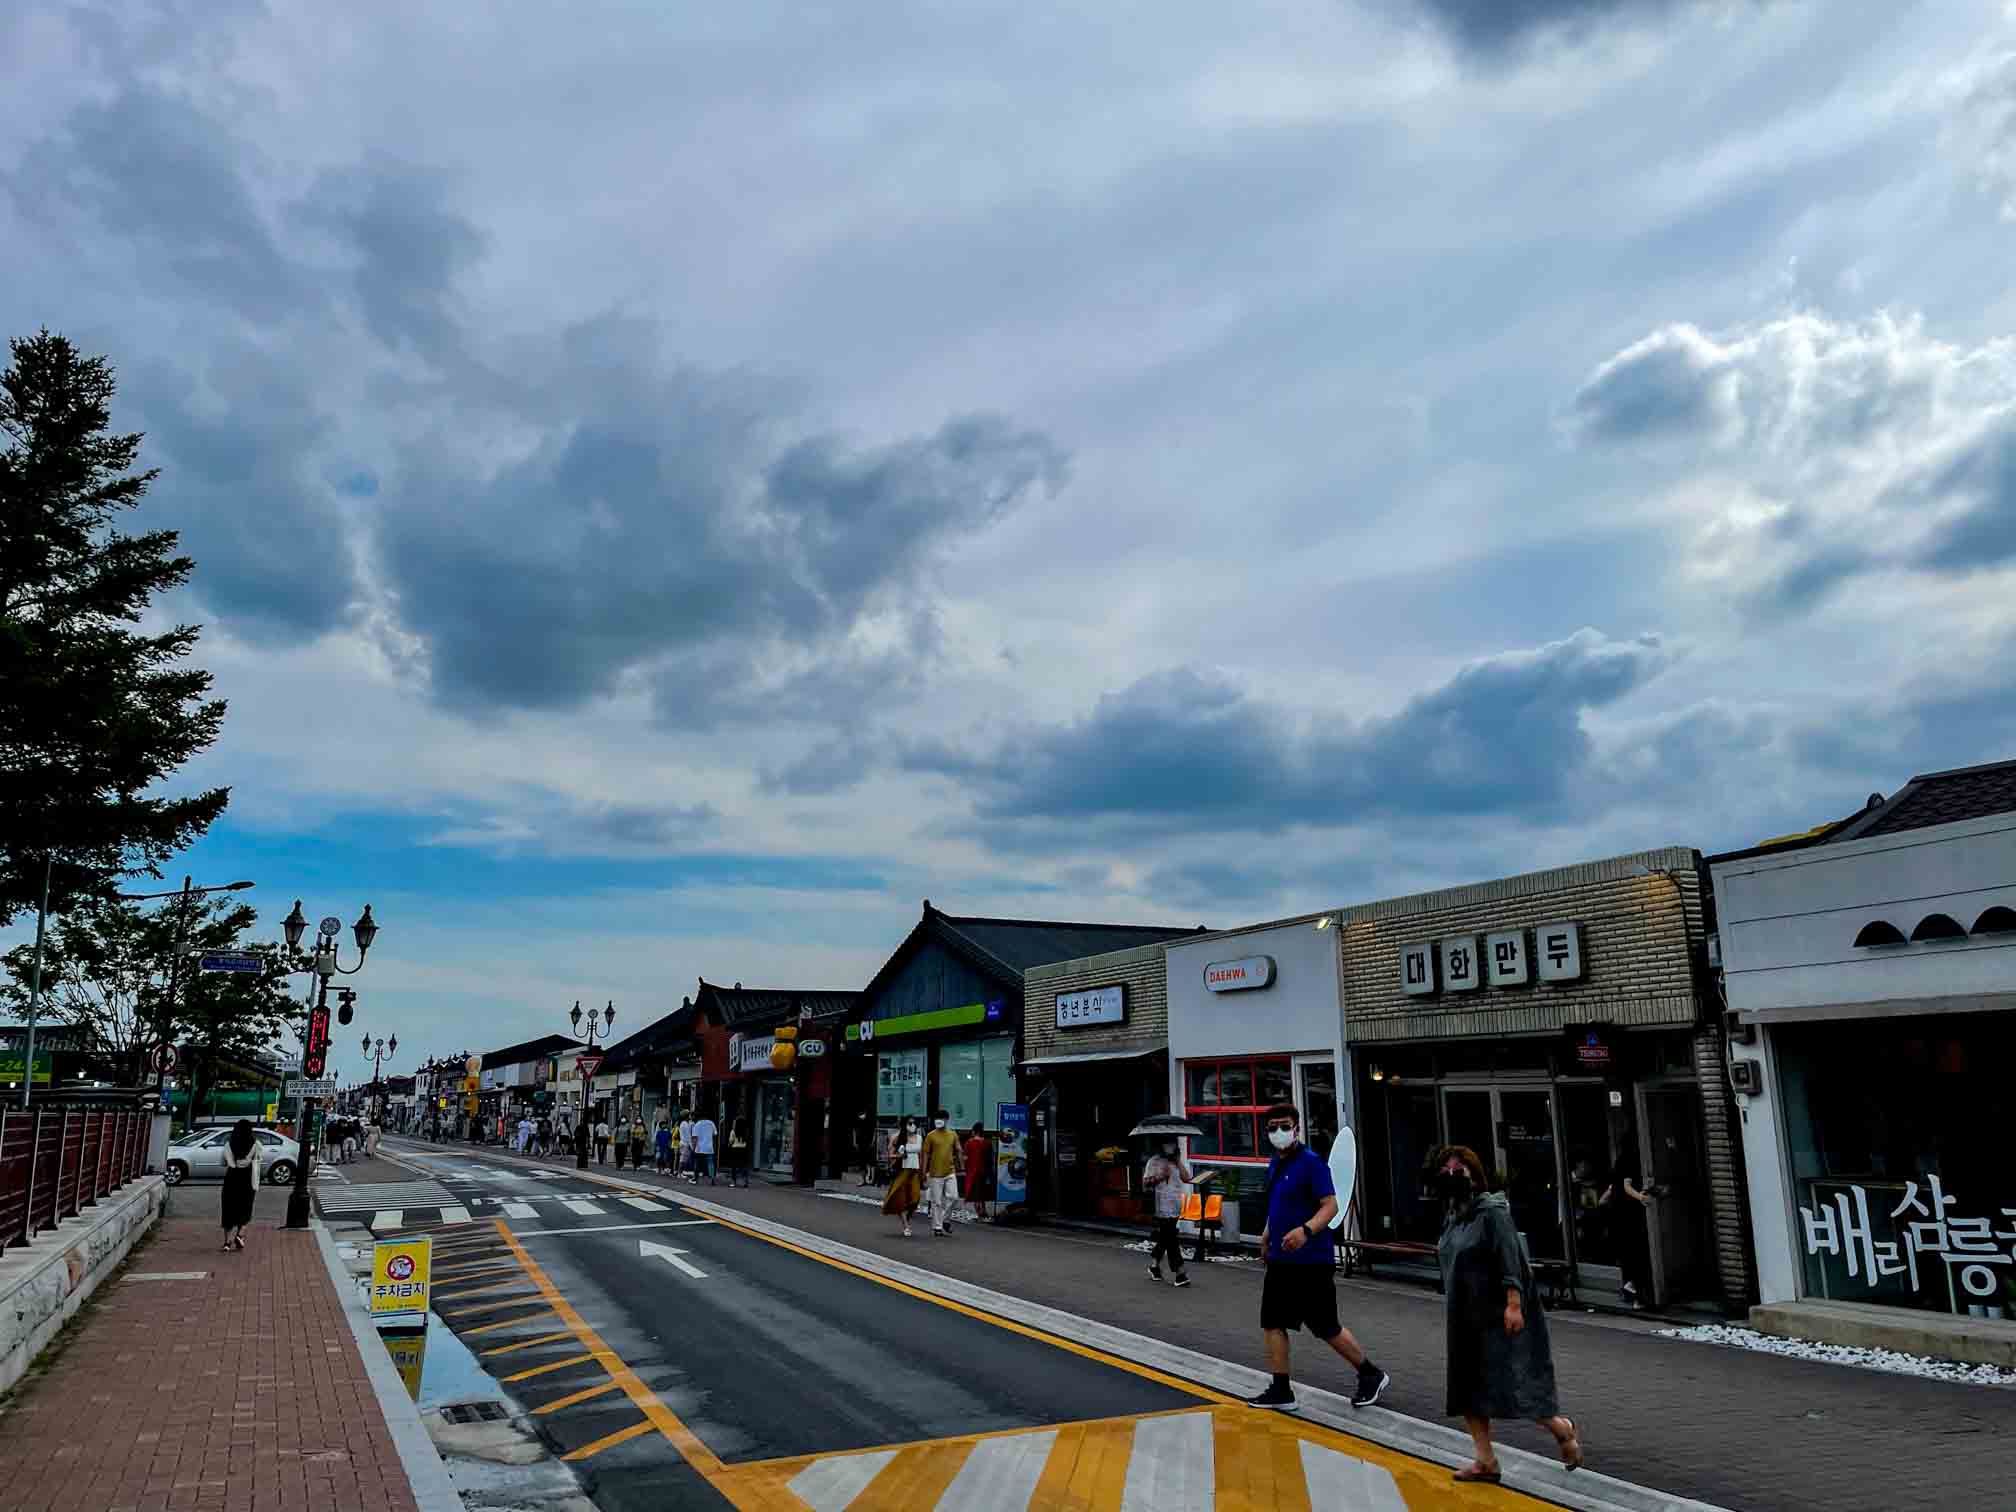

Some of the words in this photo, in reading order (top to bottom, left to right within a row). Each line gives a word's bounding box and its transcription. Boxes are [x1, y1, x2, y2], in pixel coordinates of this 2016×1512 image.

[1407, 934, 1569, 984] 대화만두
[1210, 968, 1247, 983] DAEHWA
[859, 1020, 874, 1040] CU
[805, 1044, 821, 1054] CU
[1799, 1173, 2016, 1297] 배리삼릉
[375, 1283, 425, 1297] 주차금지
